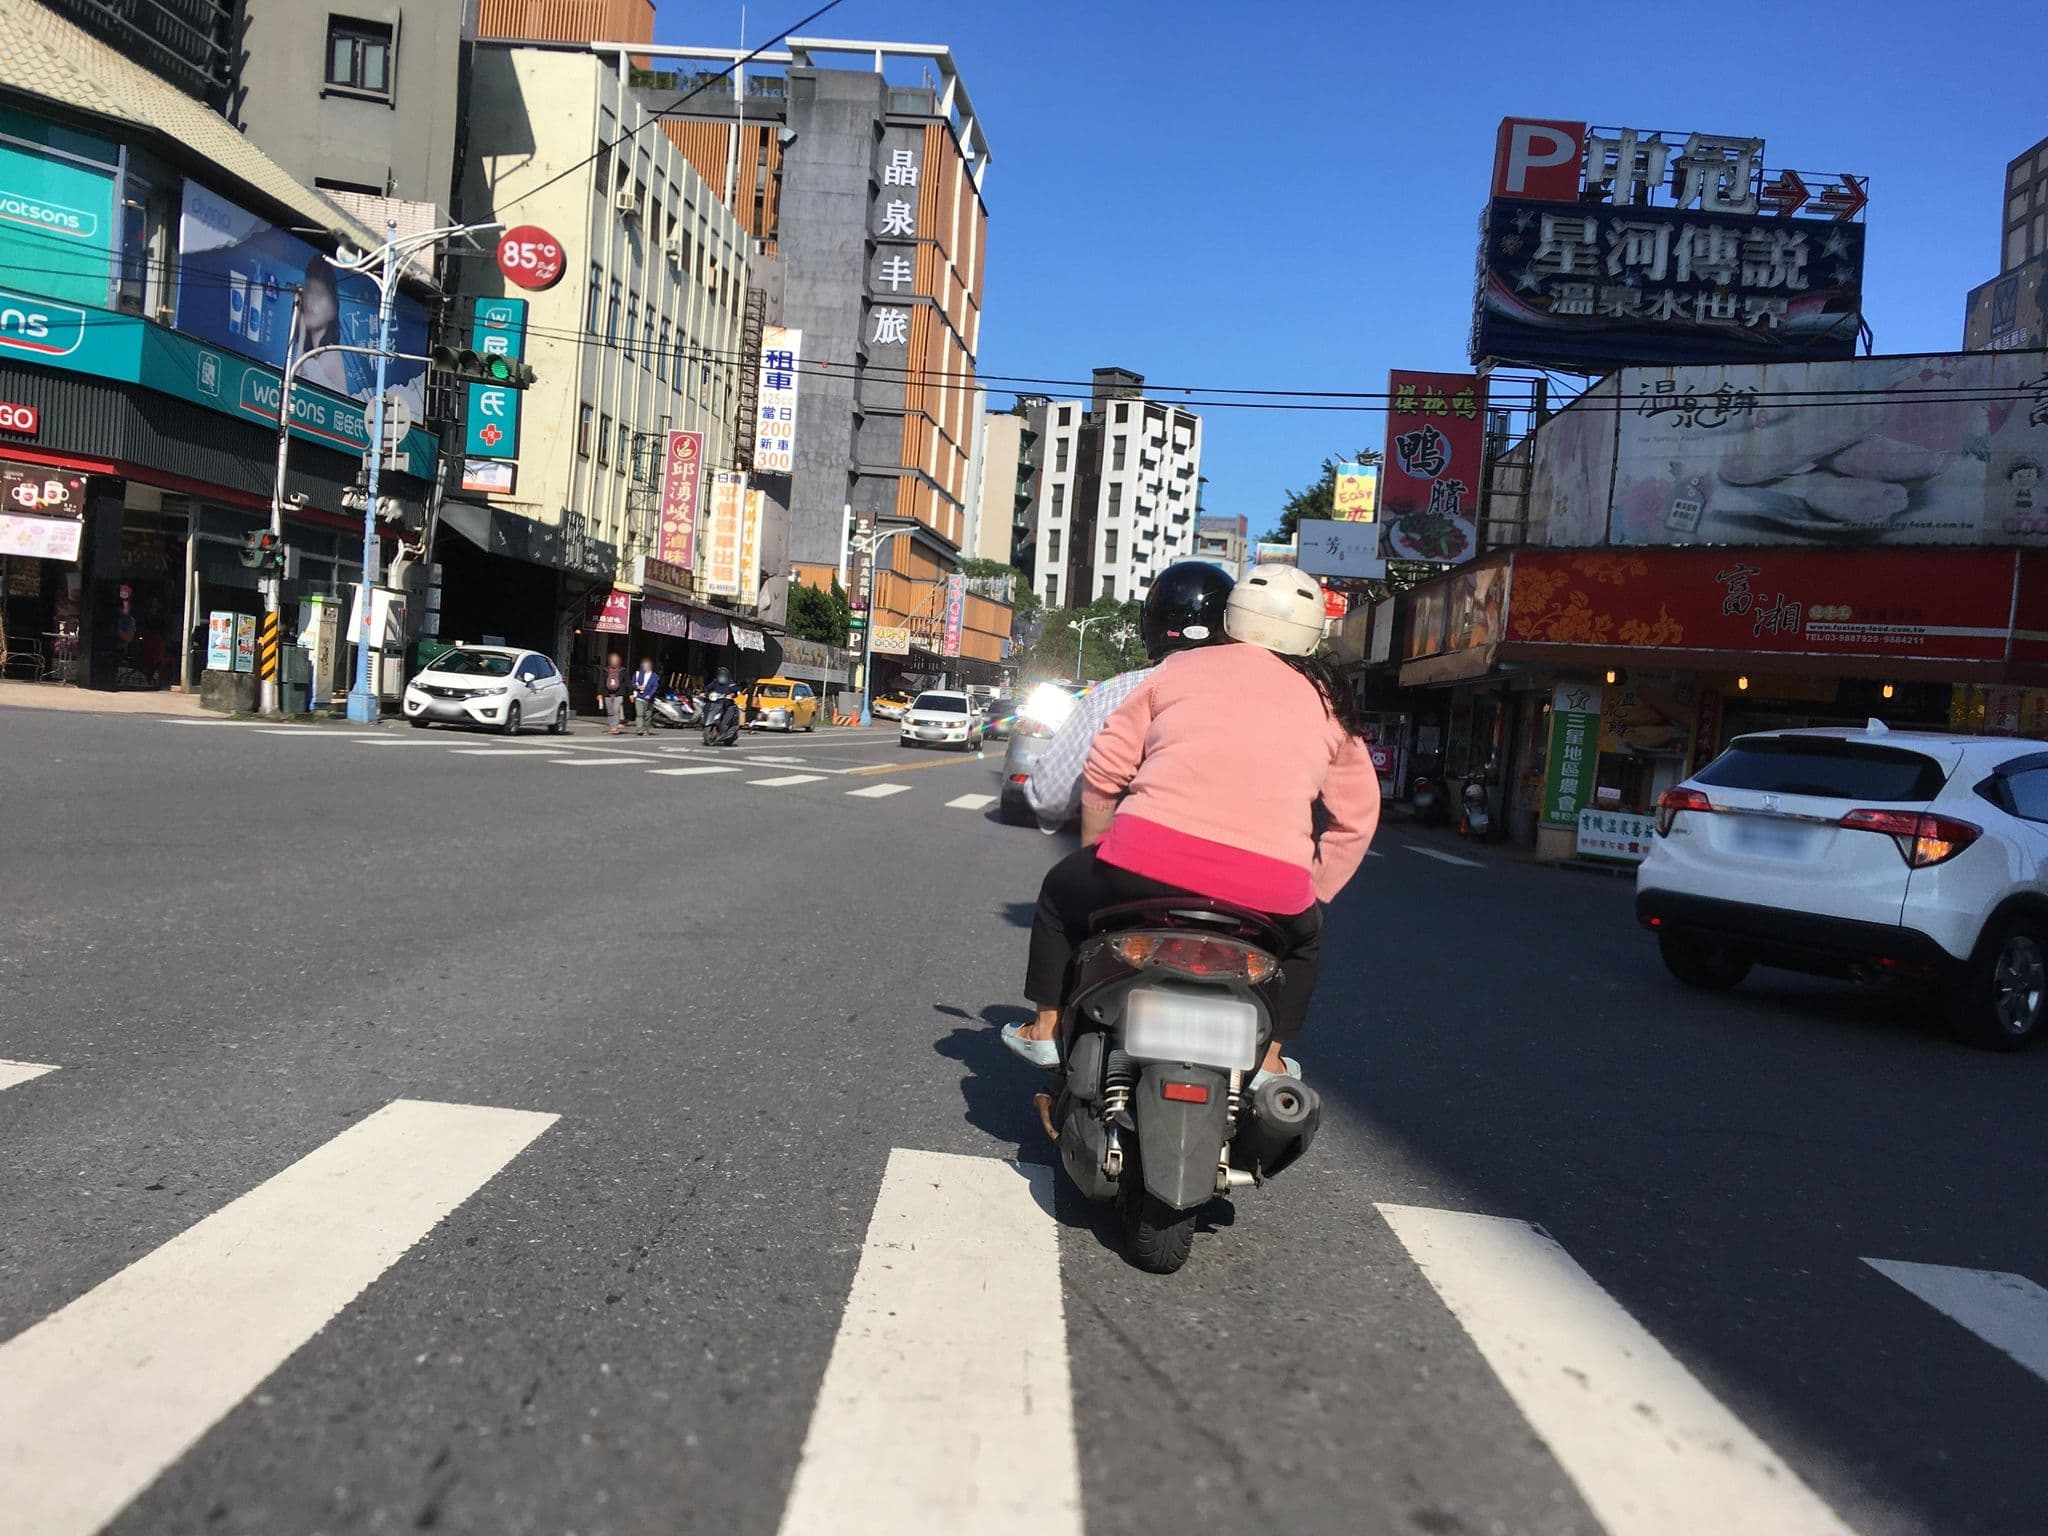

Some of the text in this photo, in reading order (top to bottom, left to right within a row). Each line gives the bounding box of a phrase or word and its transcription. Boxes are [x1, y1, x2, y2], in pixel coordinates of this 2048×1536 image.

[1506, 124, 1576, 192] P
[872, 149, 918, 345] 晶泉丰旅
[1532, 212, 1810, 290] 星河傳說
[764, 350, 794, 391] 租車
[334, 410, 365, 439] 屈臣氏
[760, 421, 792, 438] 200
[758, 452, 789, 468] 300
[1303, 536, 1341, 555] 一芳
[848, 633, 862, 648] P
[1557, 713, 1587, 812] 三星地區農會
